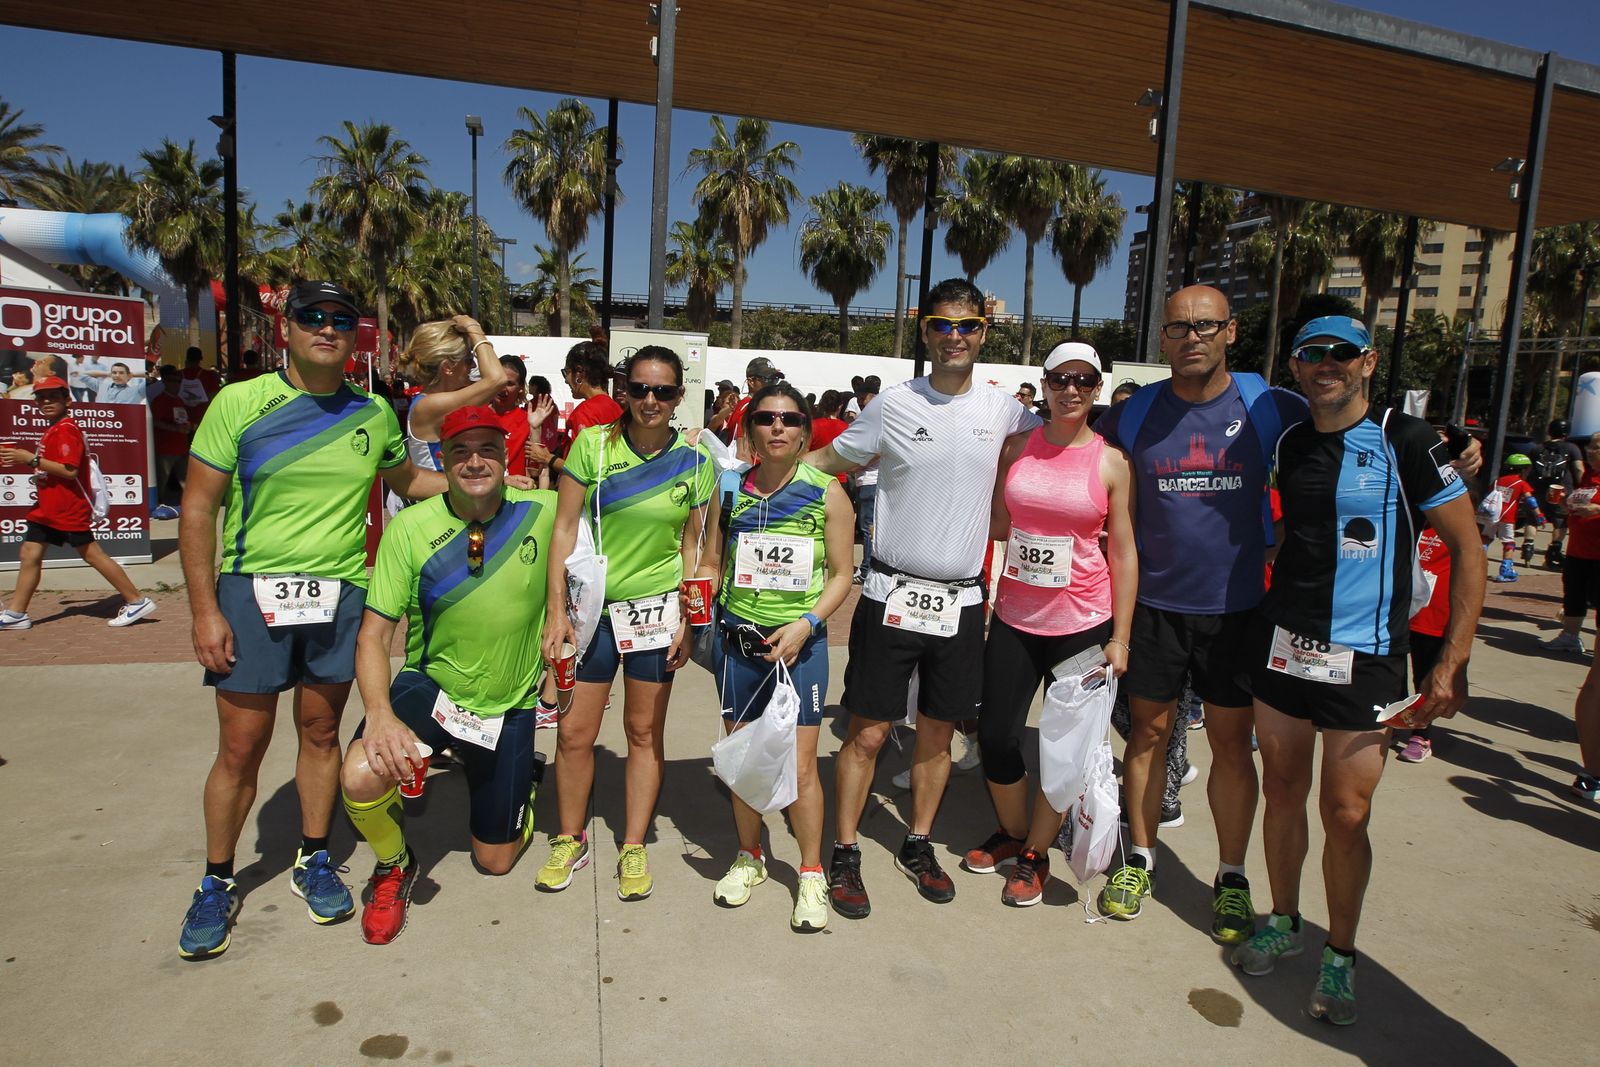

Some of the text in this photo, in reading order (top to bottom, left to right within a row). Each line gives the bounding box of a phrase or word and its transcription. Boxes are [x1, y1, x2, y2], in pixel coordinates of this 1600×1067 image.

[44, 304, 122, 326] grupo
[46, 323, 135, 344] control
[47, 341, 95, 351] seguridad
[13, 416, 28, 426] lo
[74, 418, 123, 429] alioso
[1158, 475, 1243, 492] BARCELONA
[117, 517, 142, 531] 22
[754, 546, 794, 564] 142
[1019, 545, 1055, 565] 382
[275, 580, 321, 600] 378
[905, 591, 944, 612] 383
[628, 605, 665, 626] 277
